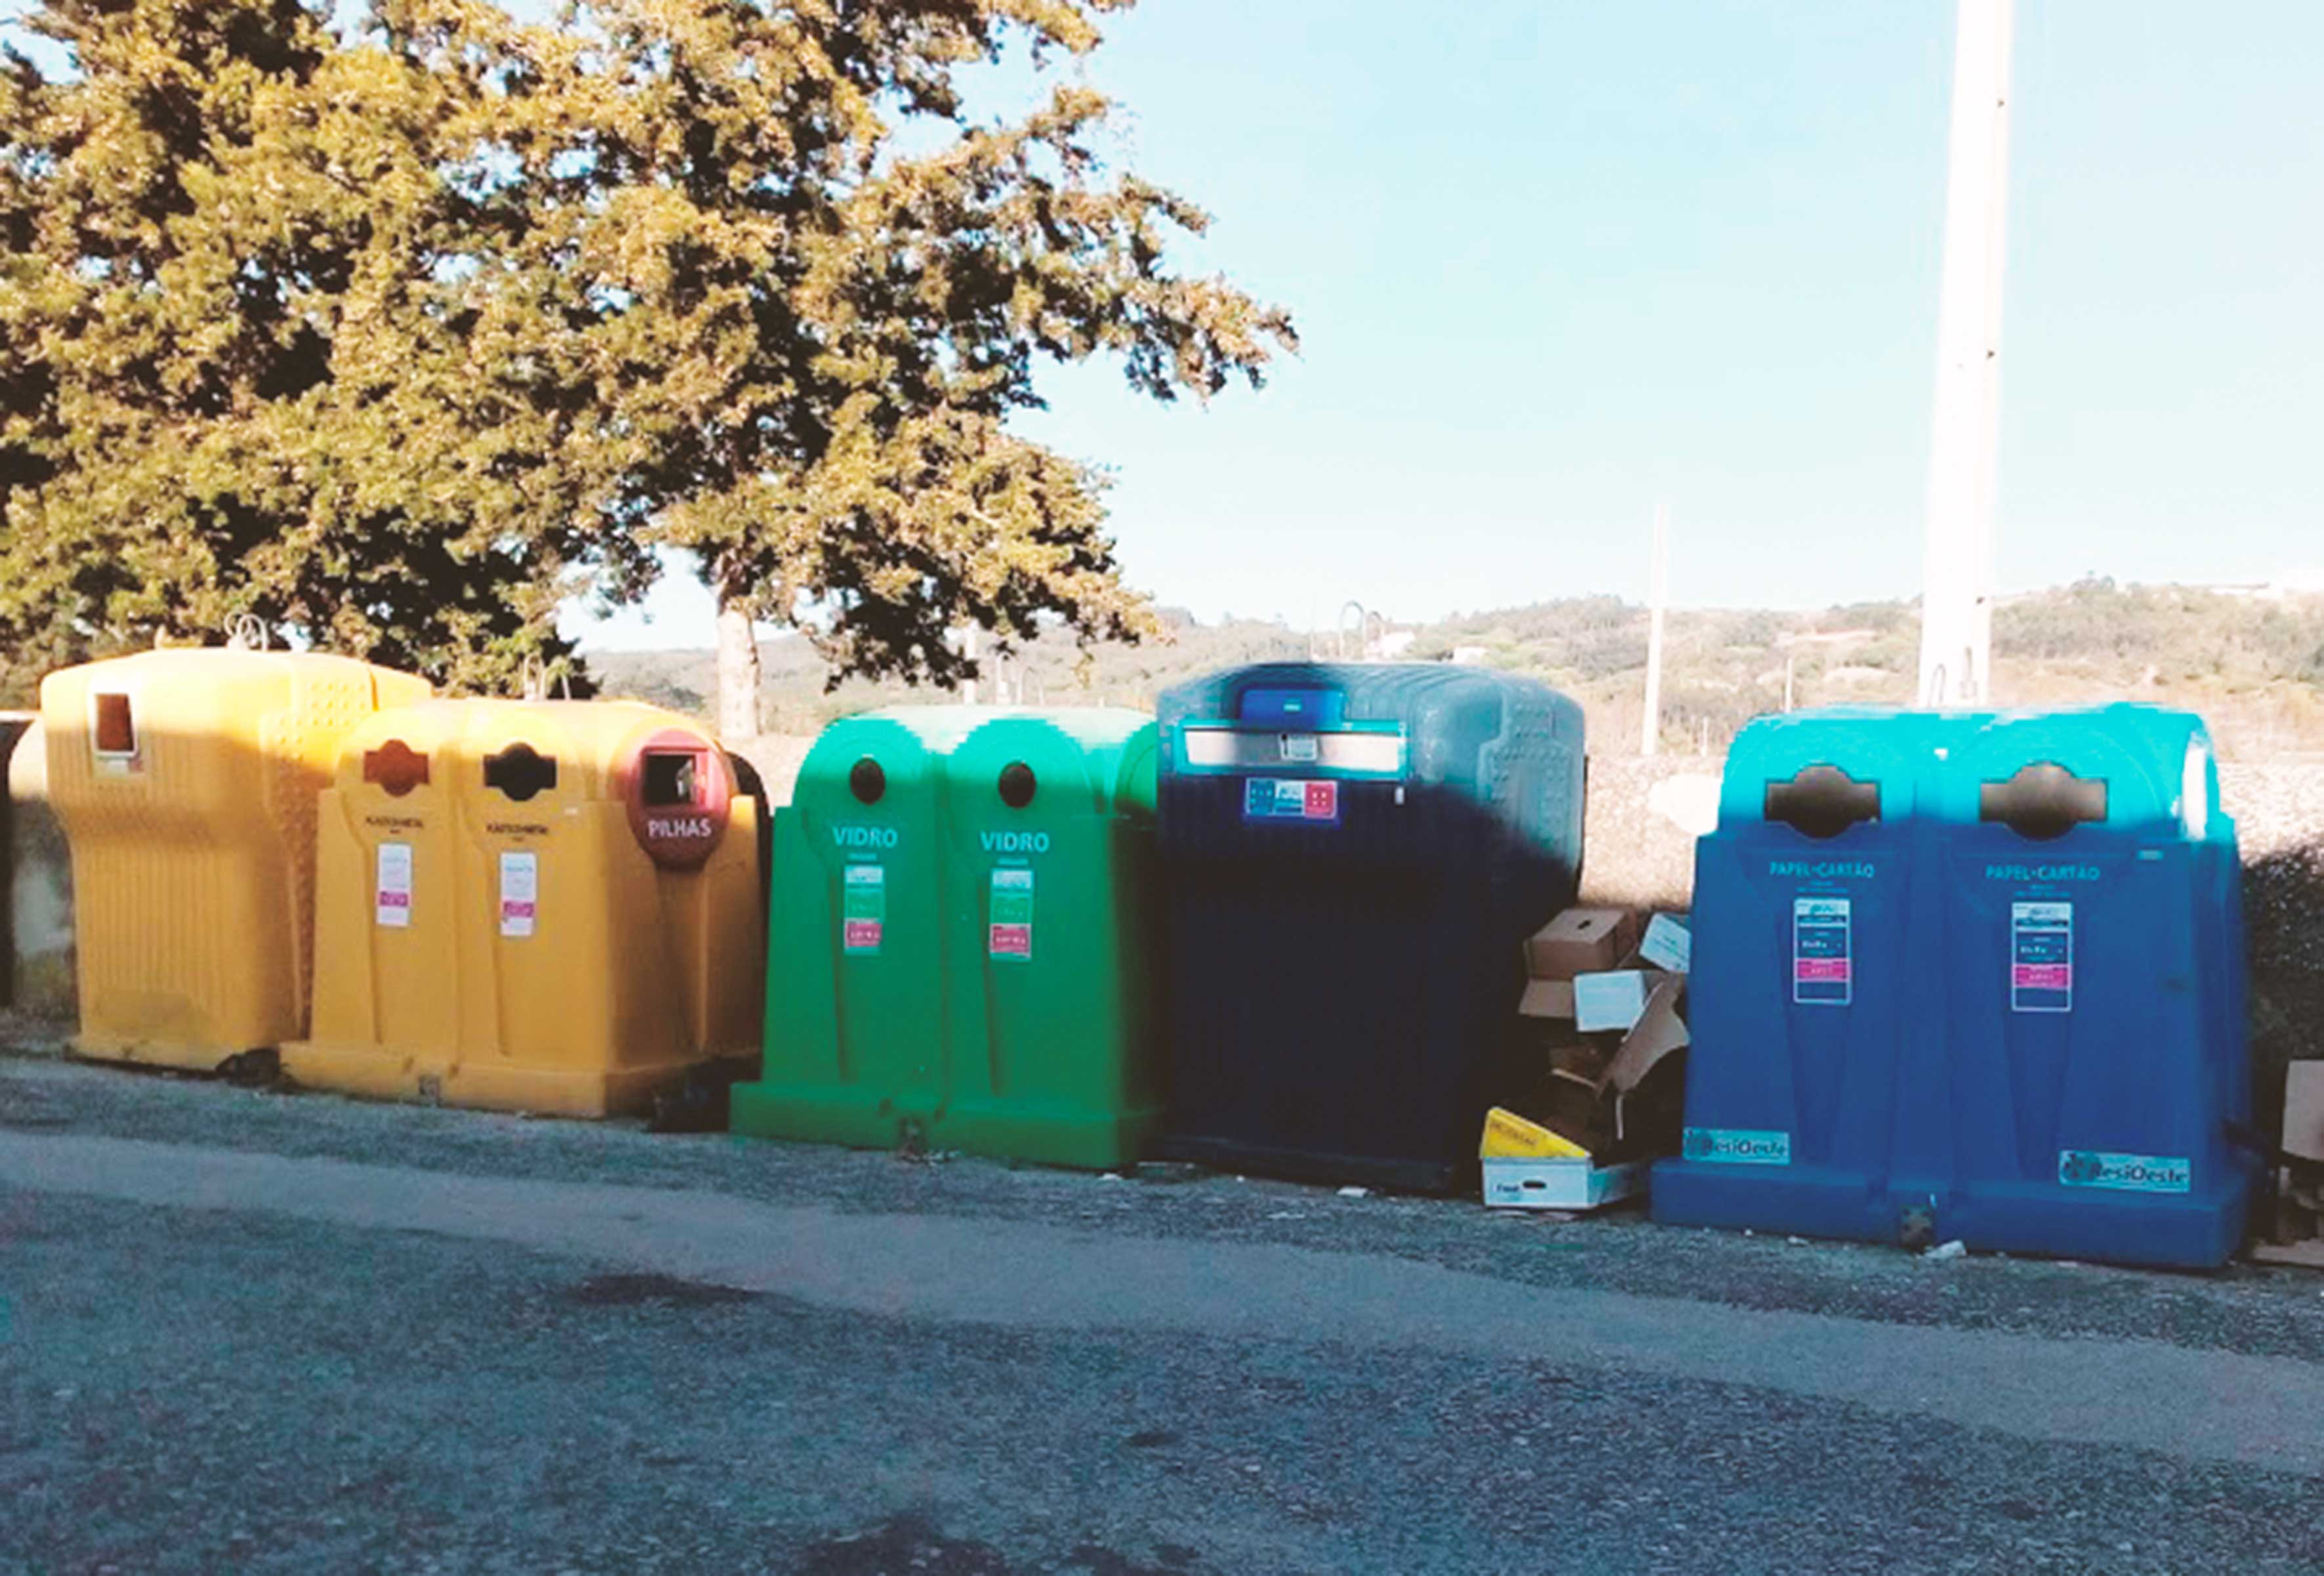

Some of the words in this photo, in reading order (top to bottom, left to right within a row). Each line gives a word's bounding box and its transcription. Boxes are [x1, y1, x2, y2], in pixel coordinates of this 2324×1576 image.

[647, 818, 712, 837] PILHAS
[832, 826, 898, 848] VIDRO
[980, 829, 1050, 852] VIDRO
